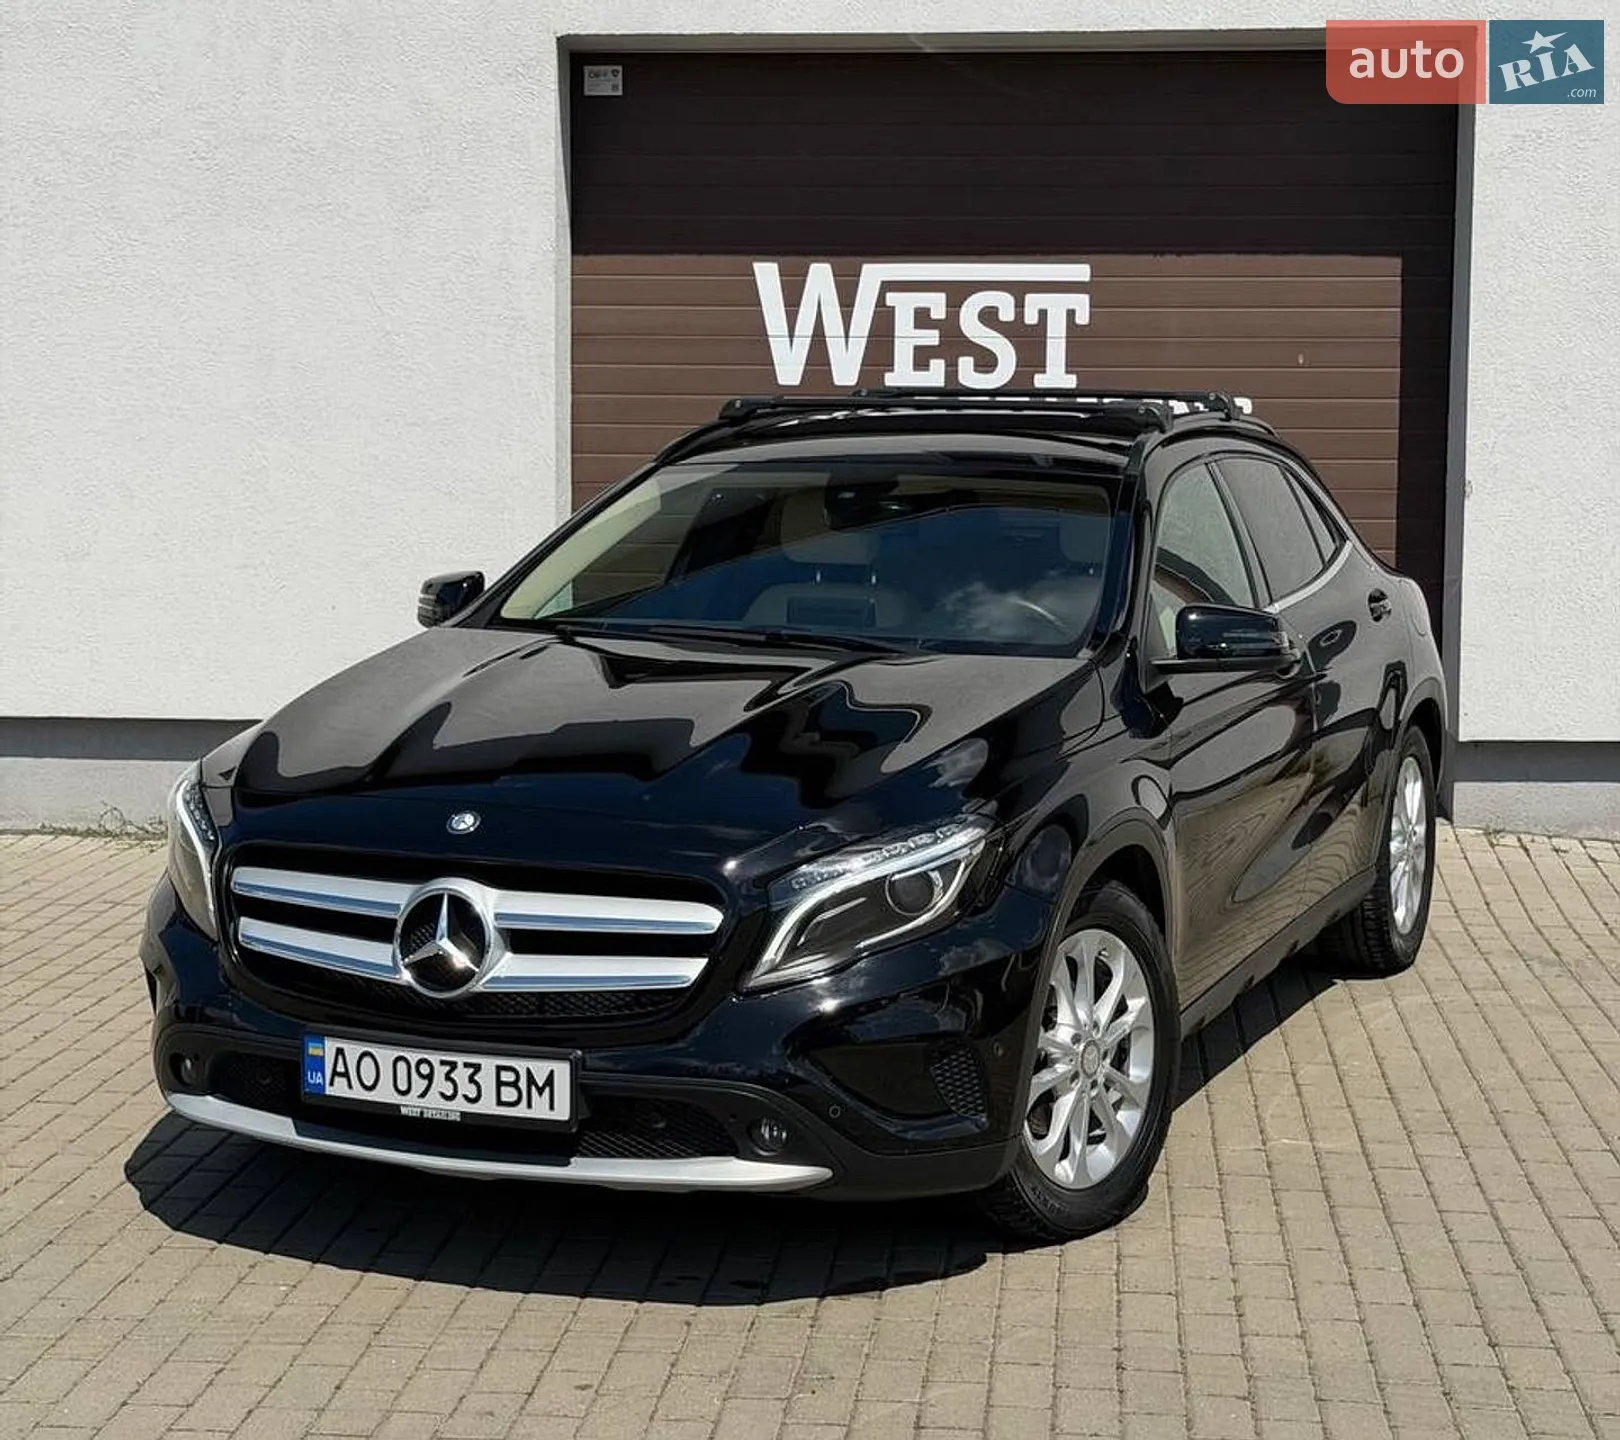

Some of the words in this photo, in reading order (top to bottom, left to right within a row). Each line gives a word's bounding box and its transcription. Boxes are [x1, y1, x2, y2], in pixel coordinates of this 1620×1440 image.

[752, 261, 1091, 389] WEST
[307, 1071, 323, 1085] UA
[328, 1047, 381, 1092] AO
[392, 1055, 483, 1105] 0933
[495, 1064, 556, 1112] BM
